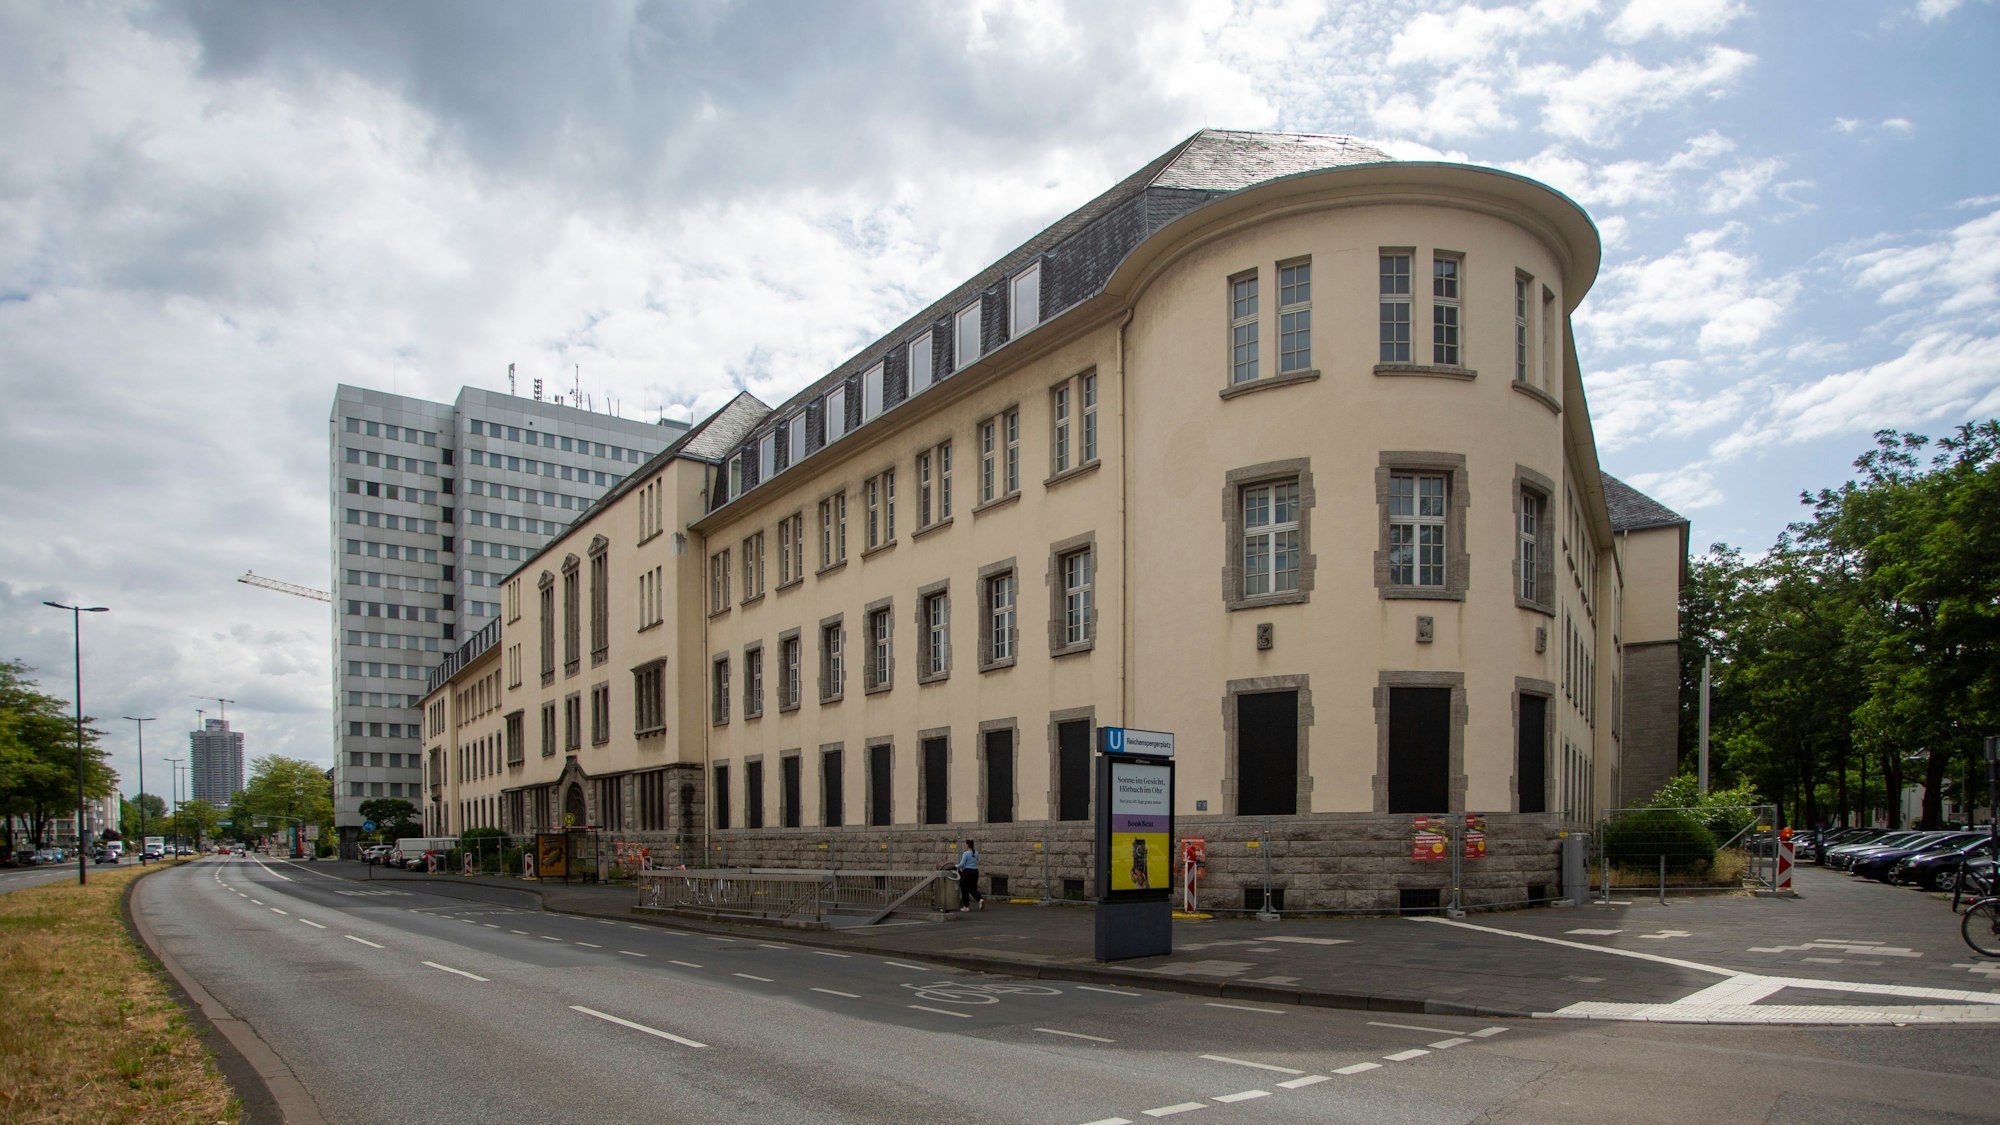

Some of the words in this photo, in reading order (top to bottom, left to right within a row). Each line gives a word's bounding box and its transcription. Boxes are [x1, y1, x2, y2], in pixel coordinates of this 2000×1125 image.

[1110, 730, 1122, 750] U
[1126, 737, 1171, 749] Reichenspergerplatz
[1144, 778, 1166, 786] Gesicht,
[1120, 786, 1143, 794] Hörbuch
